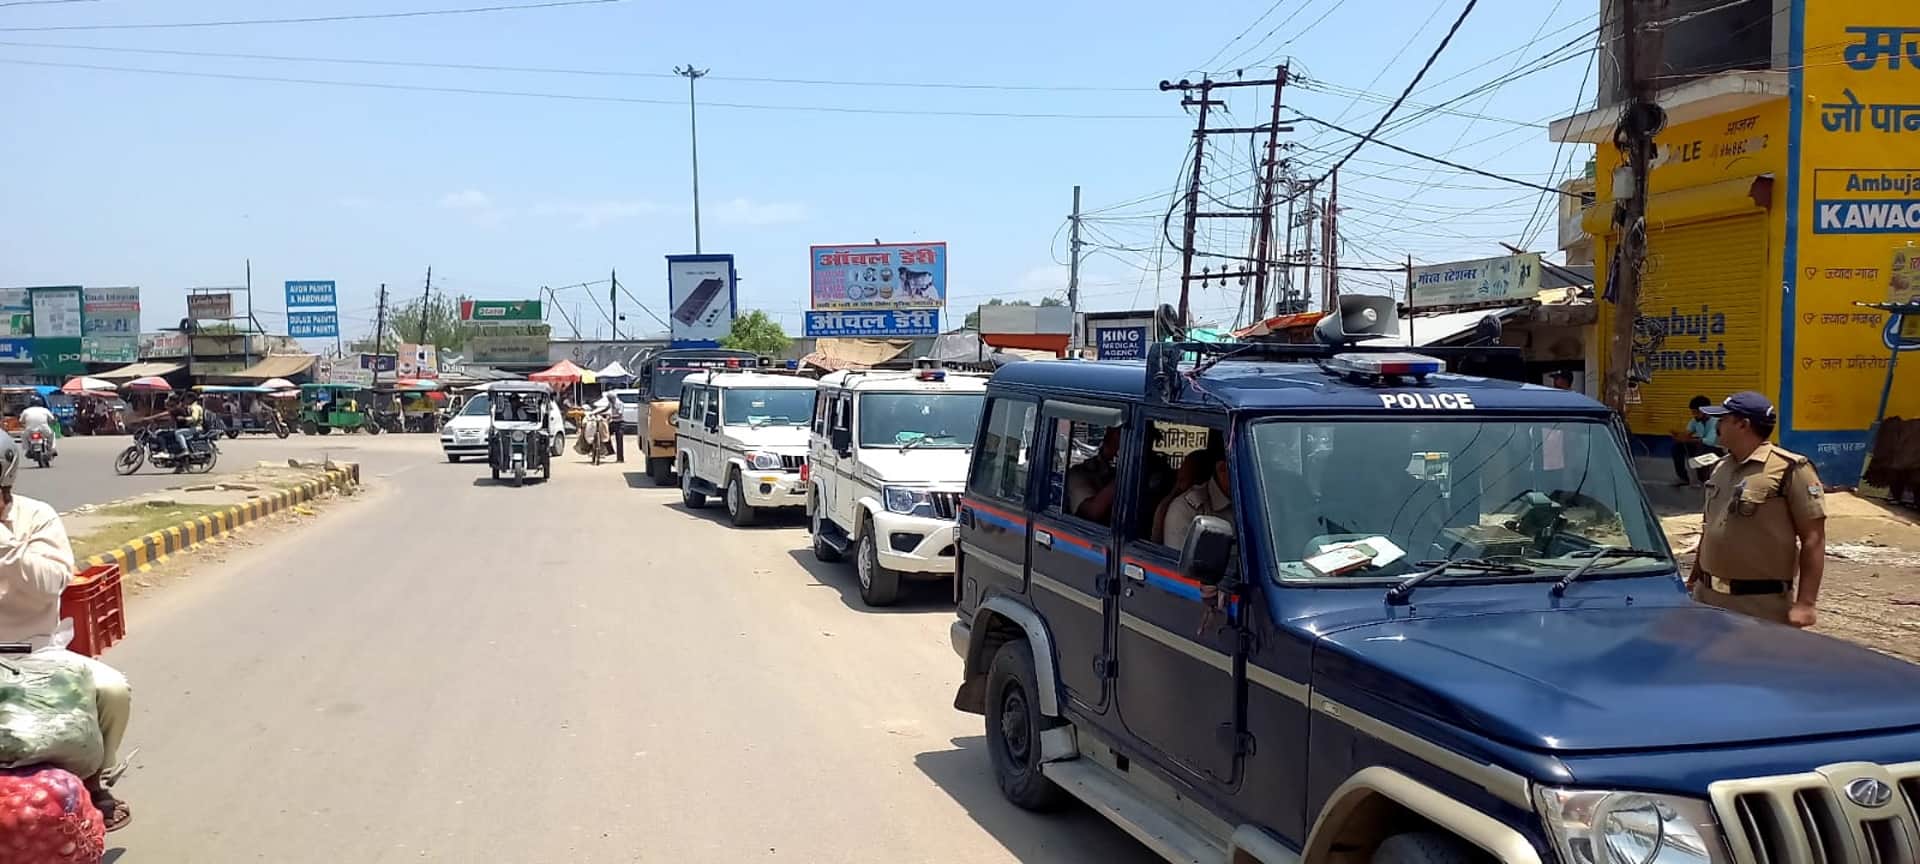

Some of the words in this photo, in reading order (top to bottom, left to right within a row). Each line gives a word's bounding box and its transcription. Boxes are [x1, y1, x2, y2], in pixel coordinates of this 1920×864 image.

[1821, 87, 1866, 133] जो
[1846, 173, 1920, 195] Ambuja
[897, 247, 938, 265] डेरी
[297, 294, 333, 304] HARDWARE
[893, 310, 936, 329] डेरी
[1103, 329, 1139, 341] KING
[1379, 392, 1475, 410] POLICE
